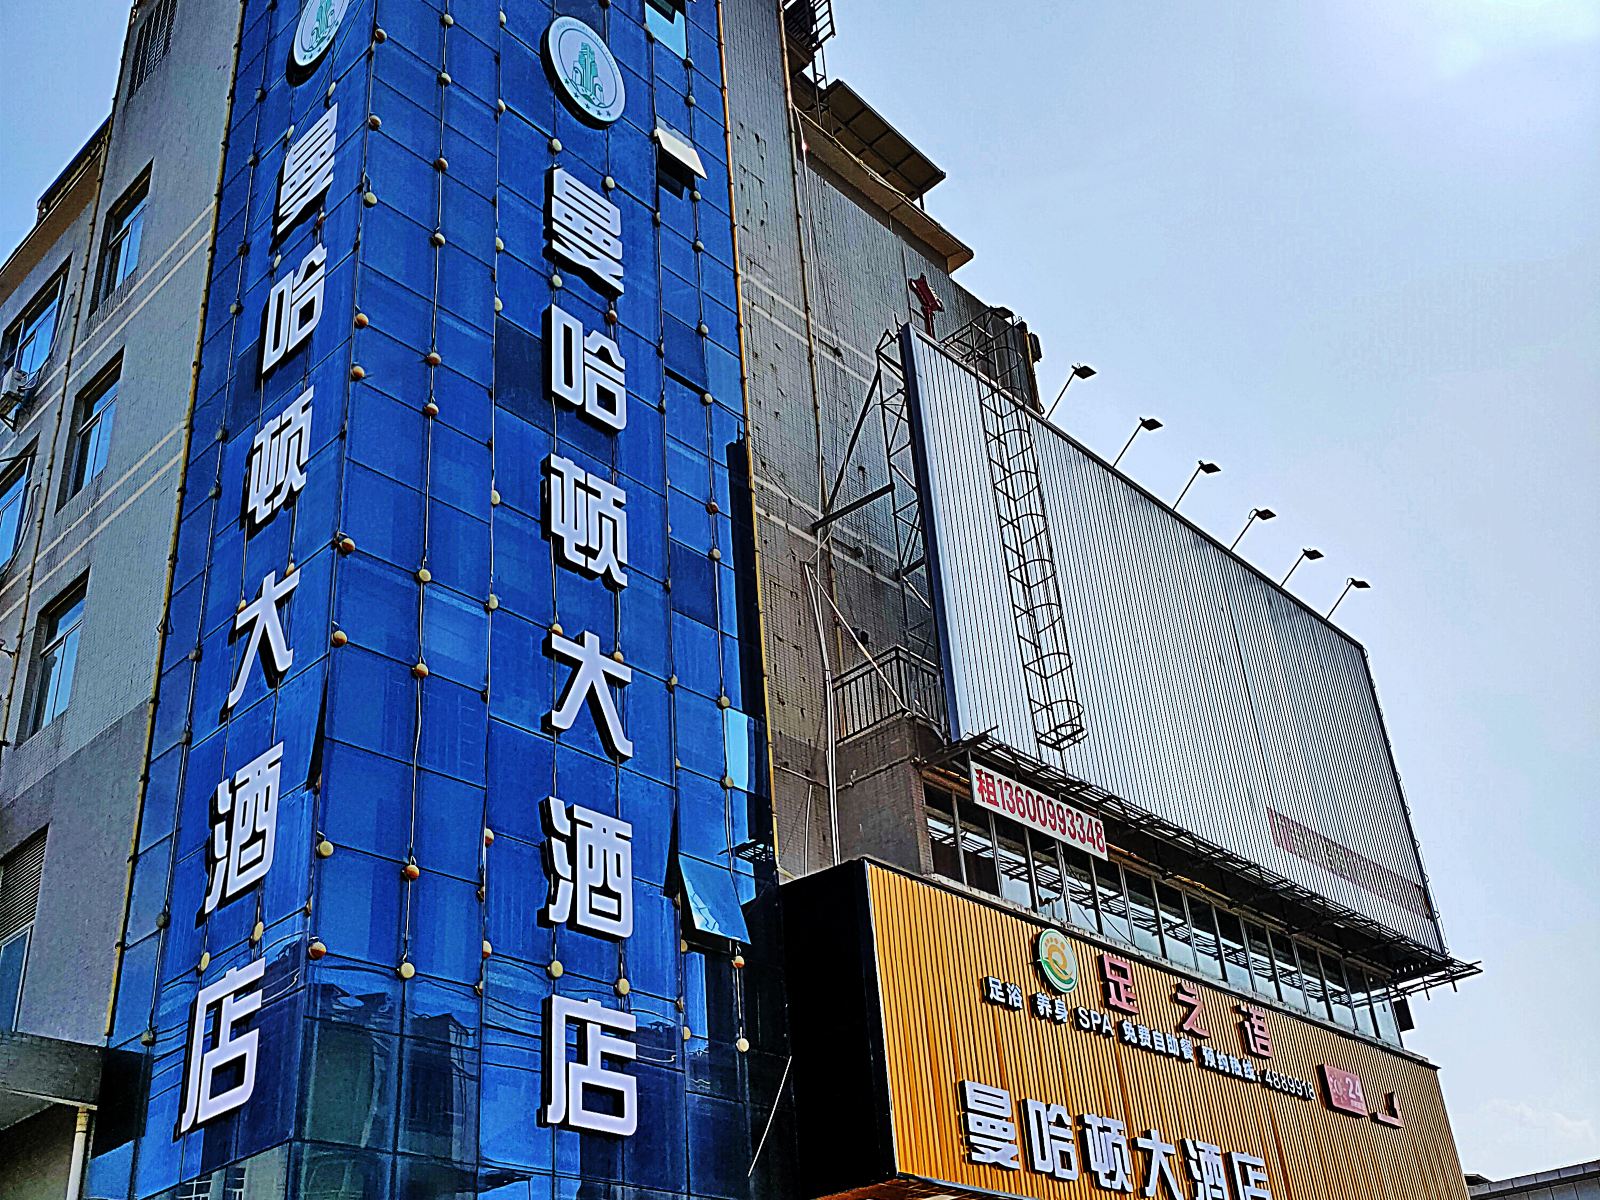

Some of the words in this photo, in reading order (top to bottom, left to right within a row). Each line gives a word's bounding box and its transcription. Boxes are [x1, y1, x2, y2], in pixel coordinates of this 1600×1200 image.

[182, 103, 338, 1134] 曼哈顿大酒店
[547, 167, 638, 1137] 曼哈顿大酒店
[975, 768, 1106, 854] 租13600993348
[987, 975, 1024, 1010] 足浴
[1035, 992, 1069, 1024] 养身
[1077, 1006, 1115, 1037] SPA
[1121, 1019, 1195, 1062] 免费自助餐
[963, 1079, 1272, 1200] 曼哈顿大酒店
